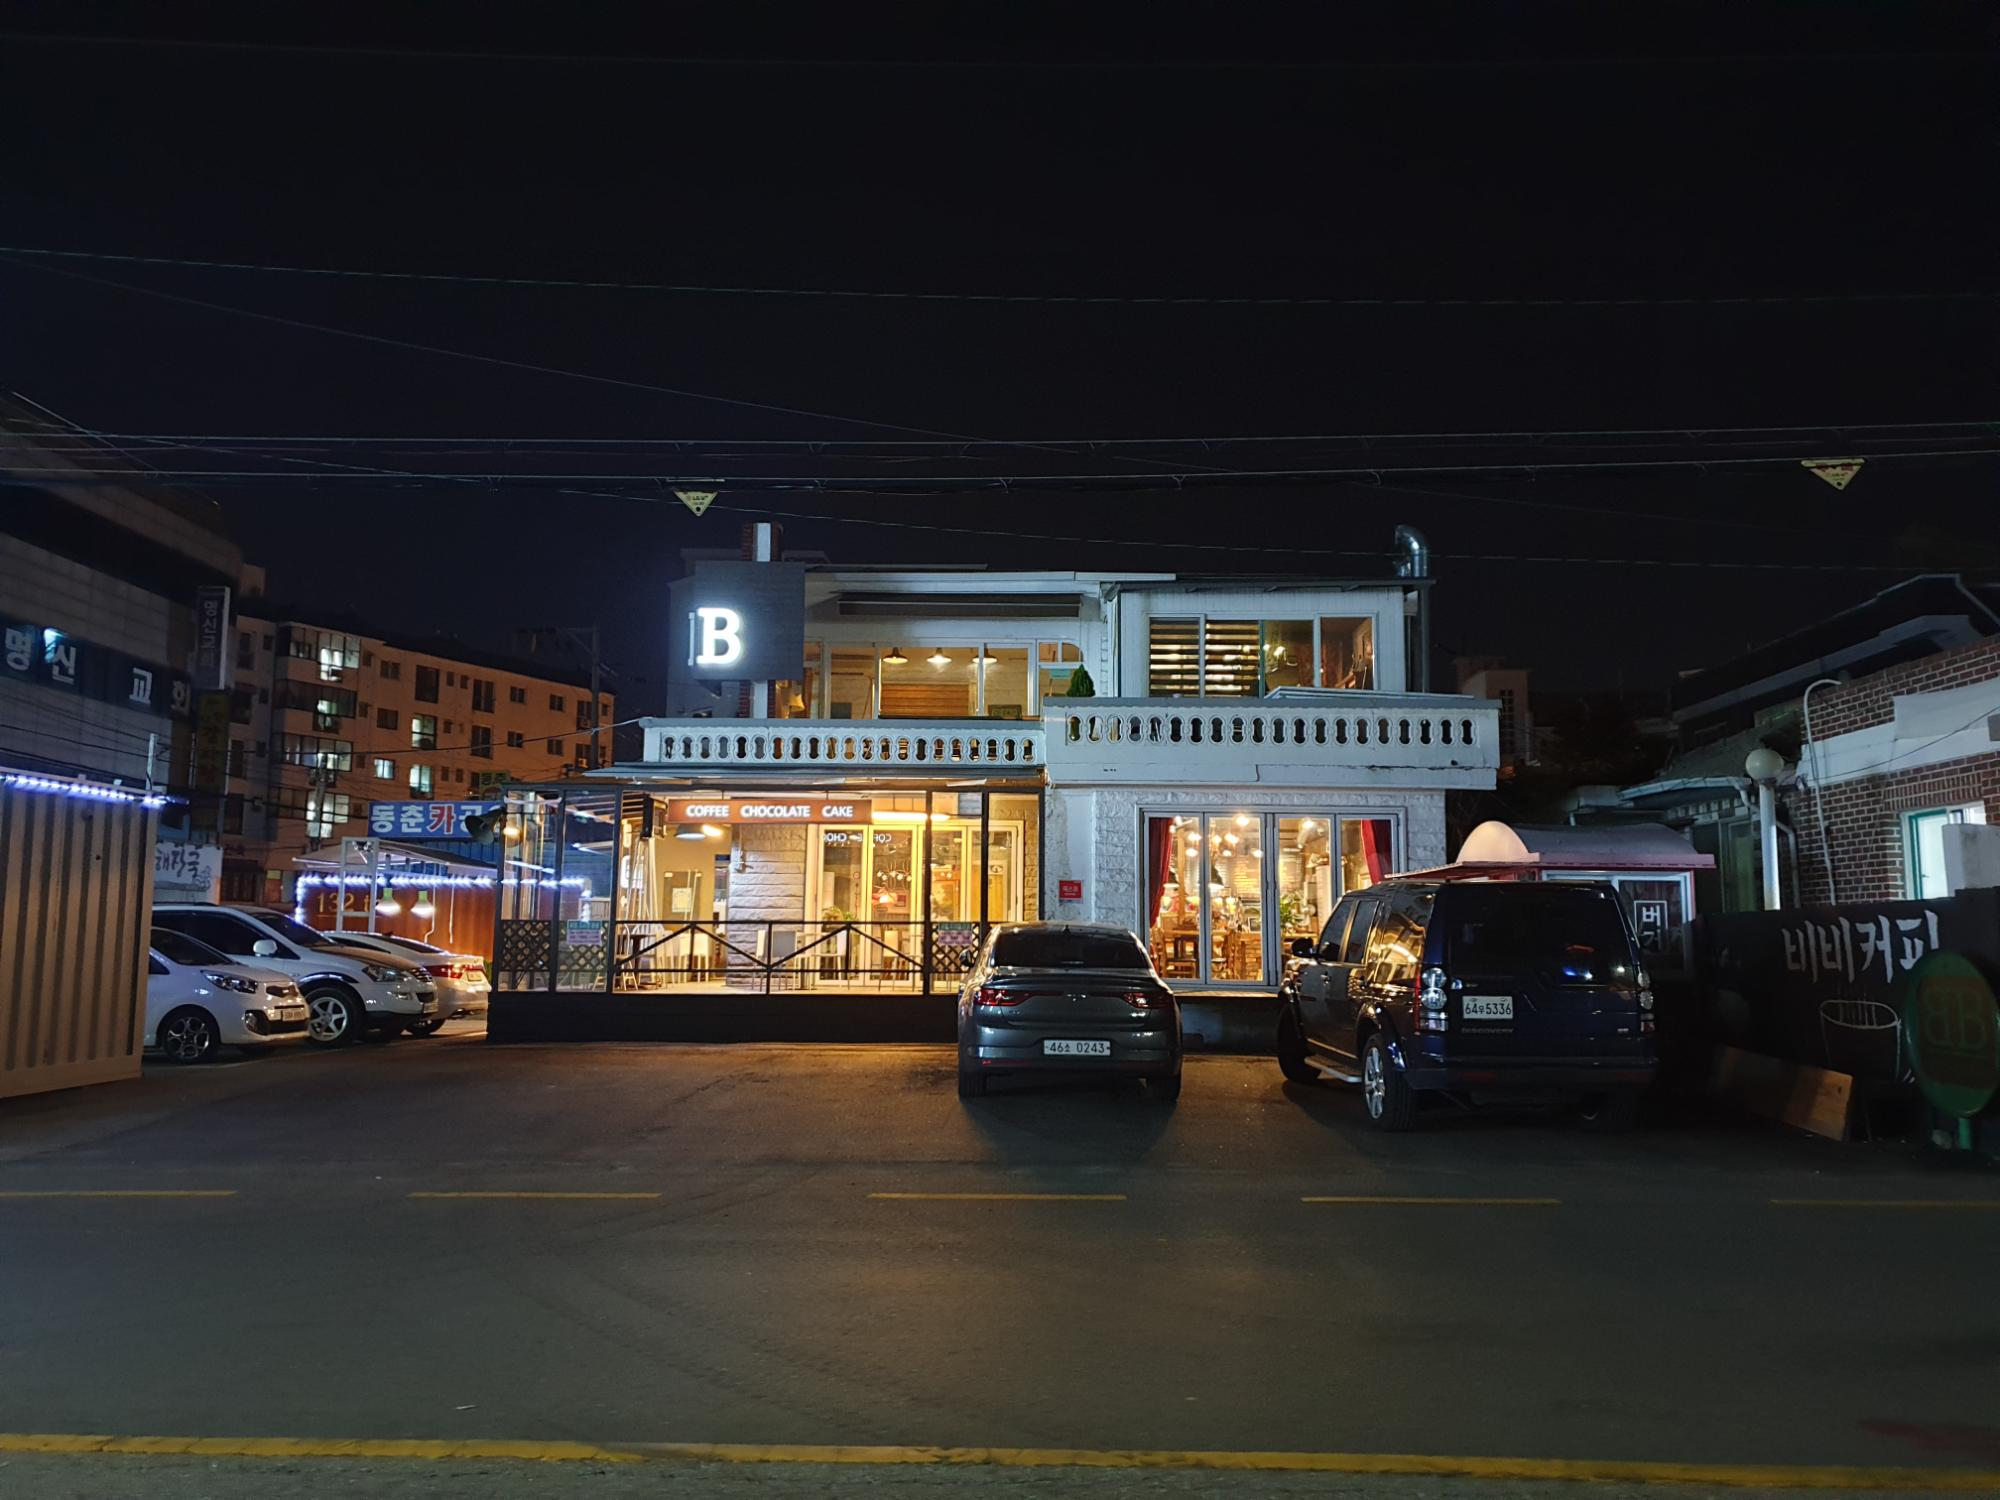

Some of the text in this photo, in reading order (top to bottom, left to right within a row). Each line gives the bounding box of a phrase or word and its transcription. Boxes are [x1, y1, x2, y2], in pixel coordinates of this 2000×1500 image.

[695, 606, 742, 665] B
[686, 805, 854, 818] COFFEE CHOCOLATE CAKE
[1781, 909, 1940, 984] 비비커피
[1076, 1042, 1105, 1053] 0243
